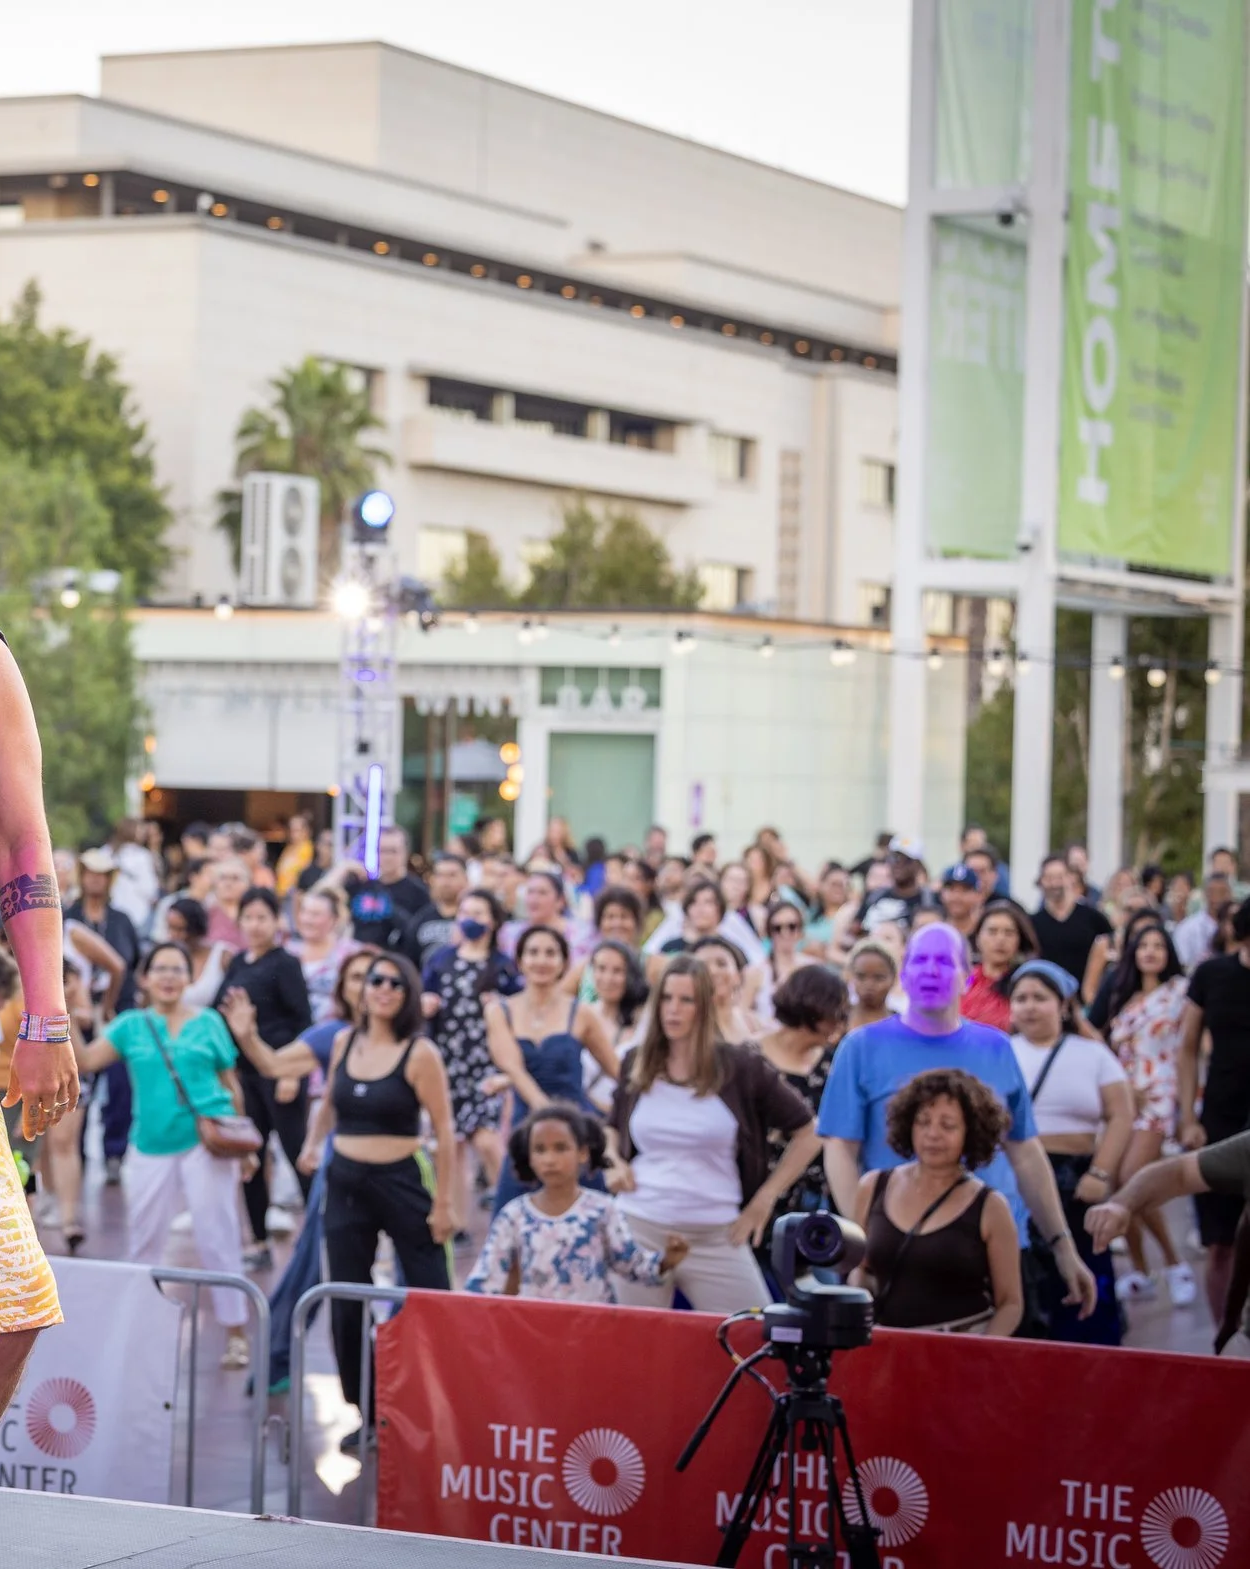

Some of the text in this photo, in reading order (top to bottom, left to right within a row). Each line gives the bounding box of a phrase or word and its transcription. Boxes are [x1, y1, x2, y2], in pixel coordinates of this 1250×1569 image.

[556, 684, 648, 719] BAR
[488, 1423, 557, 1464] THE
[441, 1463, 555, 1510] MUSIC
[1060, 1479, 1134, 1523] THE
[489, 1513, 623, 1556] CENTER
[1005, 1521, 1132, 1569] MUSIC
